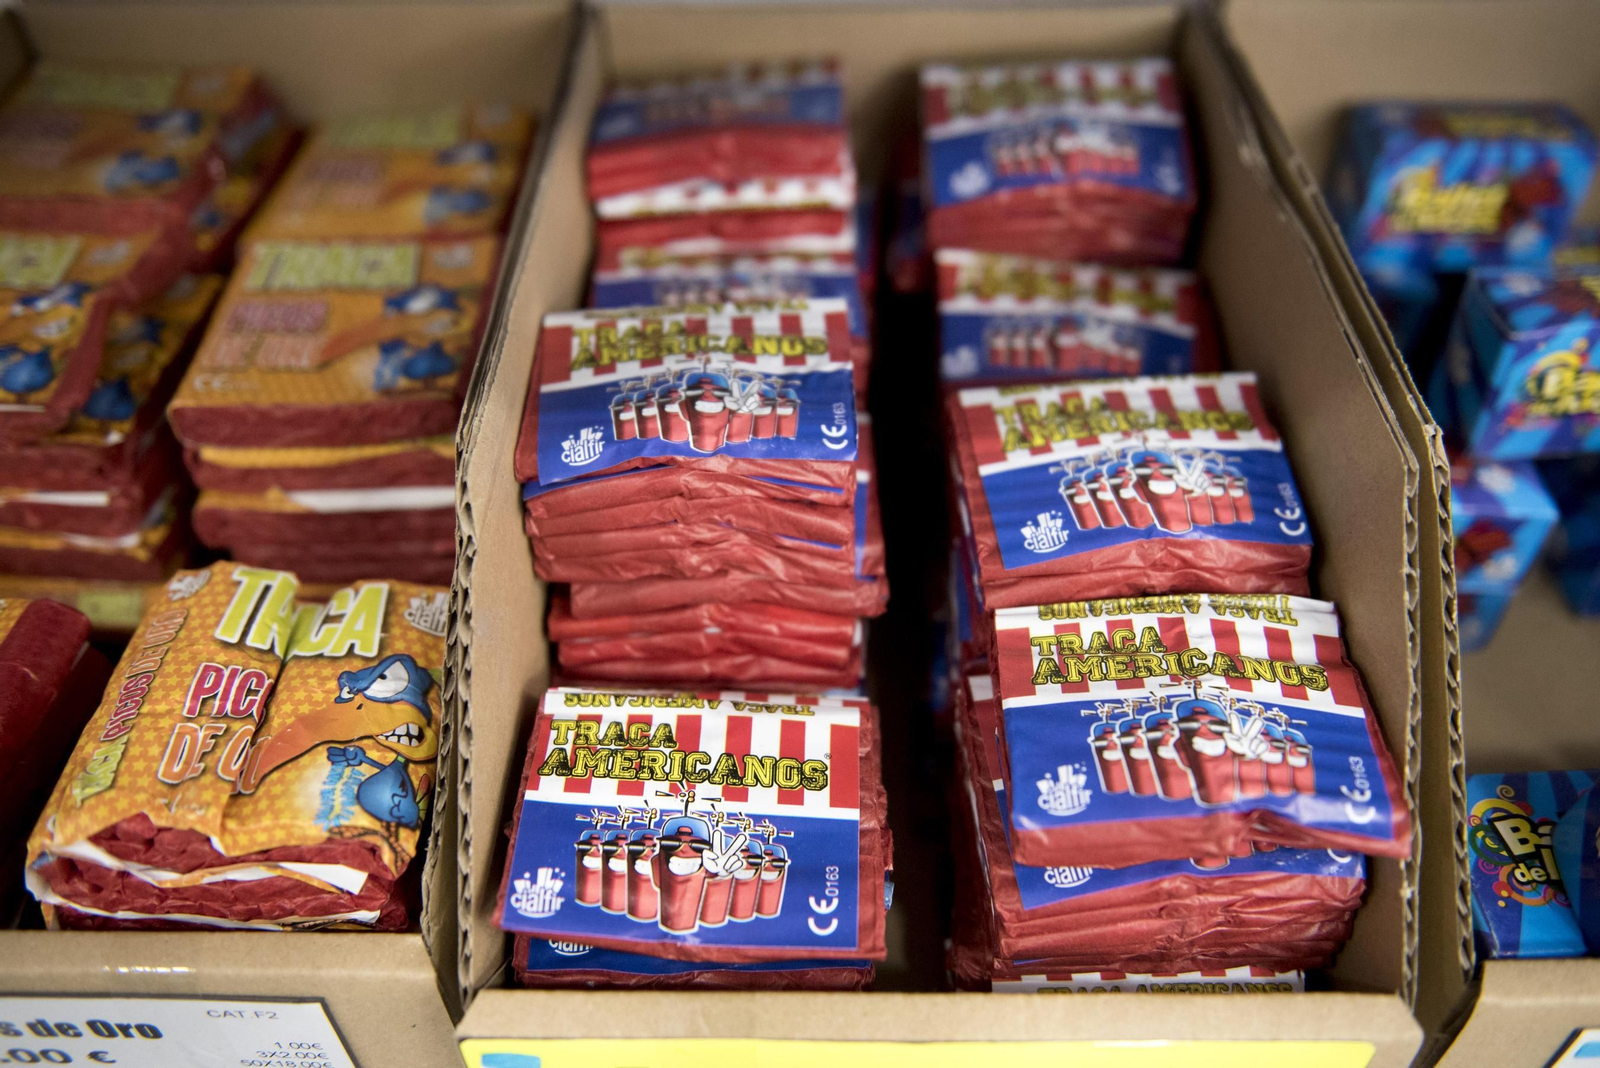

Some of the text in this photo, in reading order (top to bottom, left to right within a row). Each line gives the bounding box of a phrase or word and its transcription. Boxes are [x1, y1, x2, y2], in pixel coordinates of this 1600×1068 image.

[1030, 626, 1167, 656] TRACA
[1031, 647, 1330, 692] AMERICANOS
[551, 719, 678, 749] TRACA
[157, 722, 227, 785] DE
[538, 748, 829, 791] AMERICANOS
[825, 866, 839, 896] 0163
[26, 1018, 84, 1038] de
[86, 1019, 164, 1039] Oro
